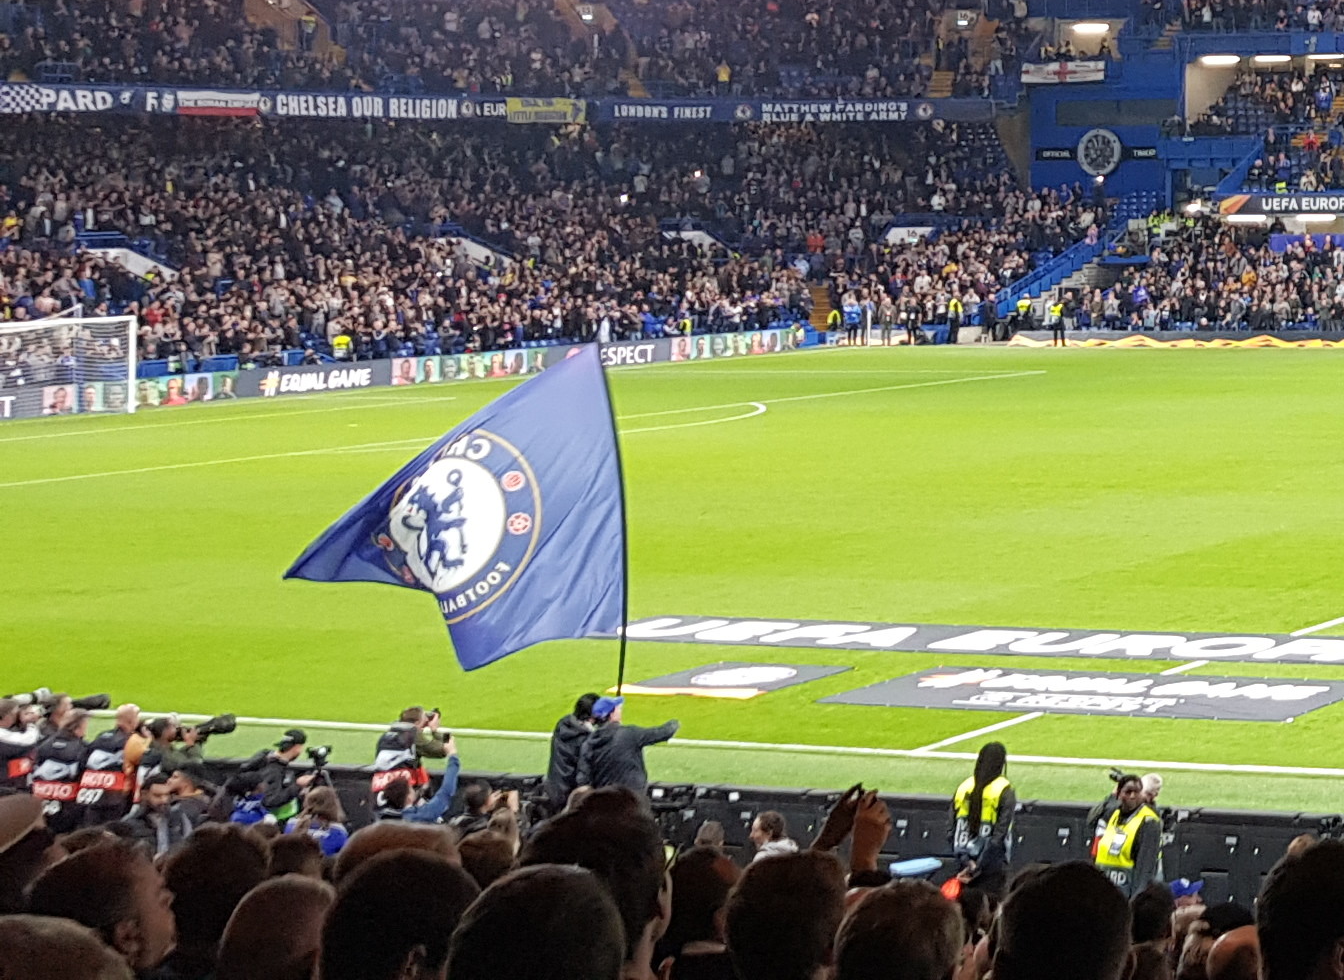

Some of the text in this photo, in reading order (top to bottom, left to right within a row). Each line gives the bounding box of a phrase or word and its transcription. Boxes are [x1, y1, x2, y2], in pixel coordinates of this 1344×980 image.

[276, 94, 458, 119] CHELSEA OUR RELIGION
[483, 102, 507, 117] EUR
[614, 105, 712, 118] LONDON'S FINEST
[761, 103, 831, 113] MATTHEW
[762, 112, 799, 123] BLUE
[820, 112, 865, 121] WHITE
[869, 111, 907, 121] ARMY
[1262, 197, 1298, 211] UEFA
[600, 344, 655, 365] ESPECT
[328, 368, 372, 388] GAME
[617, 617, 916, 655] UEFA
